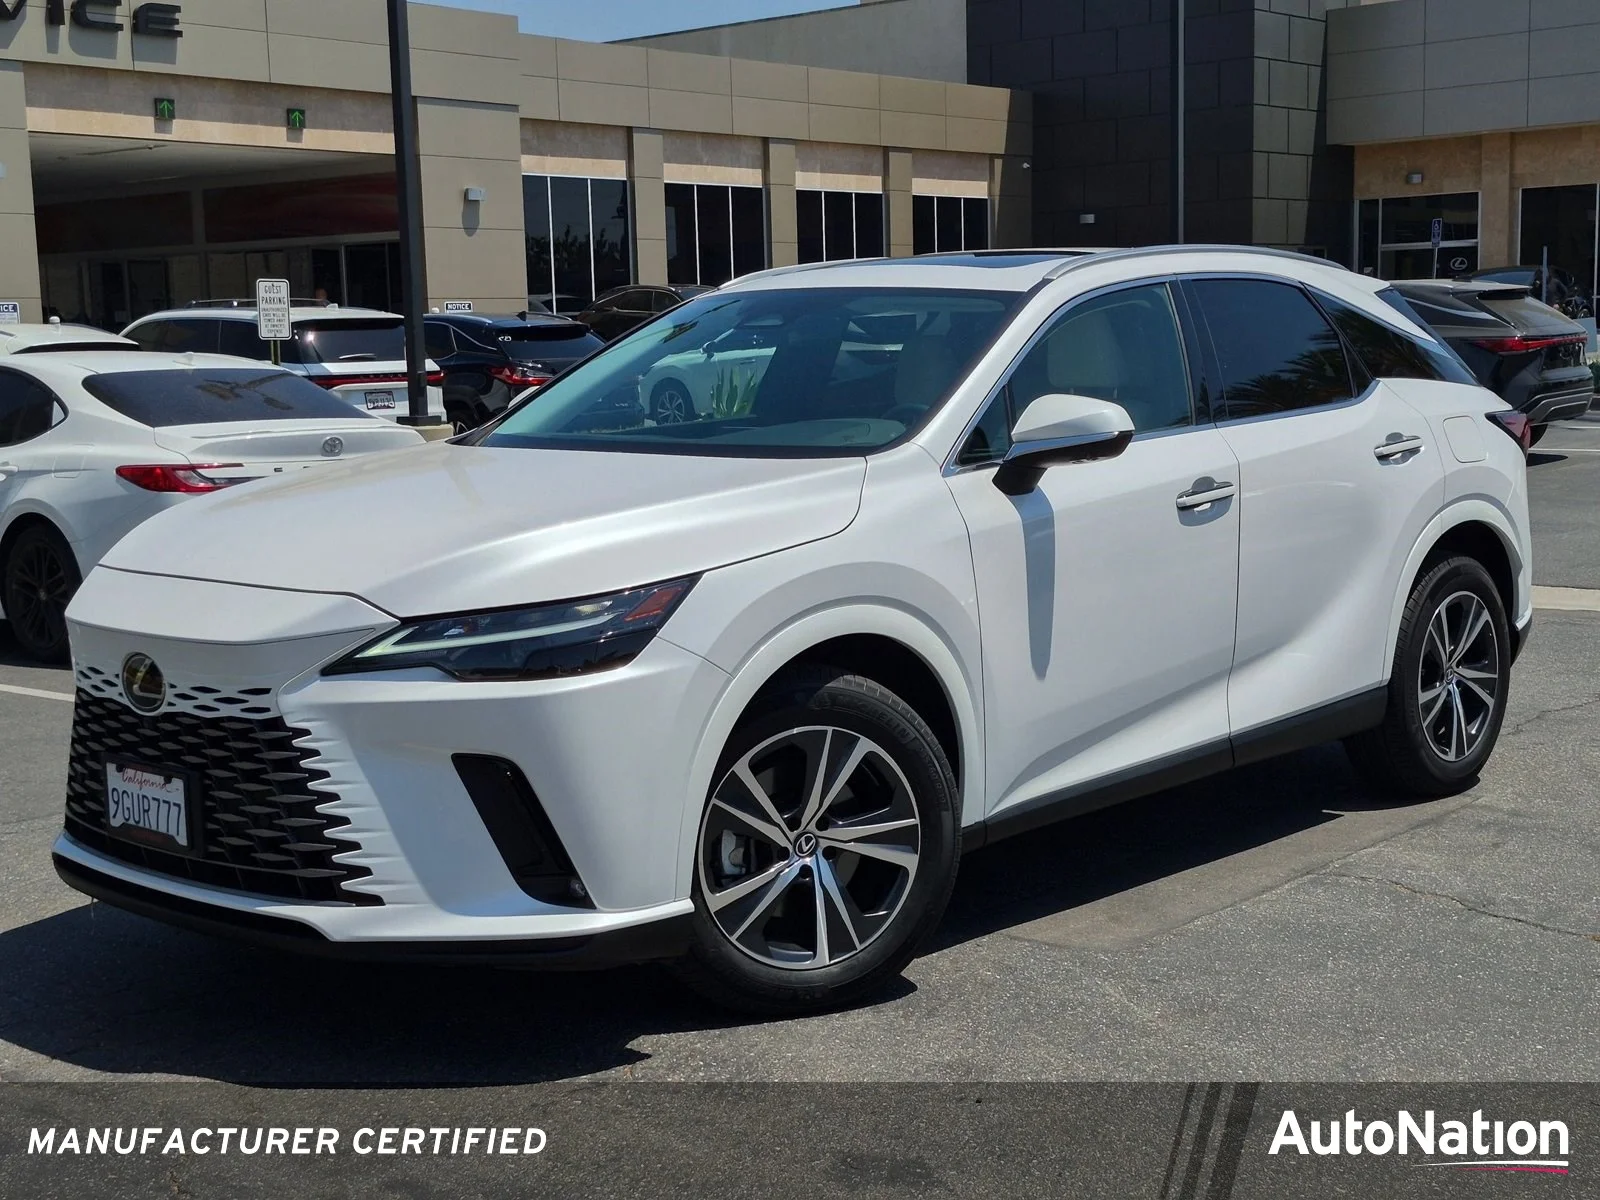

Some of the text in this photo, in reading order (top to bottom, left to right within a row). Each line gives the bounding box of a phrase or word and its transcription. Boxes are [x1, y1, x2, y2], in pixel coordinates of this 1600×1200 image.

[264, 285, 281, 294] GUEST
[261, 296, 286, 305] PARKING
[122, 767, 167, 791] California
[111, 787, 182, 836] 9GUR777
